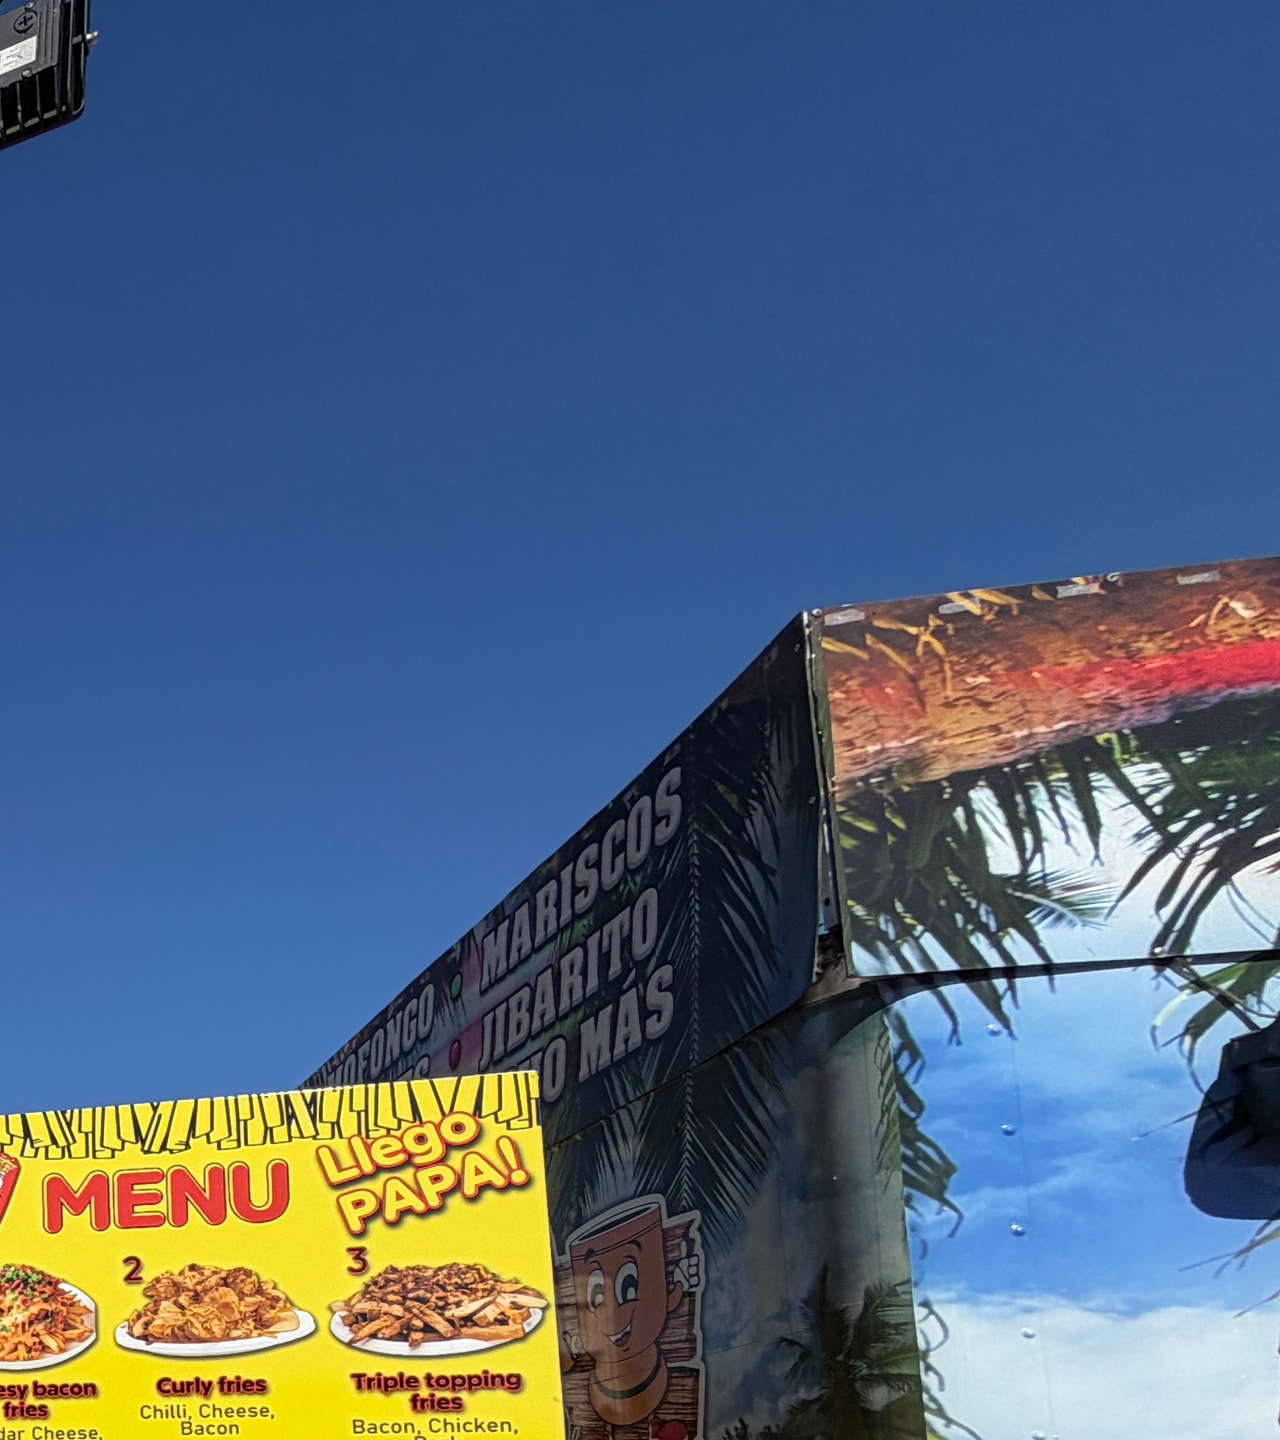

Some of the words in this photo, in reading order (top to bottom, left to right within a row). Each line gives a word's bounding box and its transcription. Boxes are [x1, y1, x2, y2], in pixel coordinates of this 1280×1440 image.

[479, 766, 682, 994] MARISCOS
[479, 888, 658, 1068] JIBARITO
[579, 963, 674, 1083] MÁS
[315, 1110, 482, 1186] Llego
[41, 1158, 291, 1234] MENU
[336, 1136, 530, 1236] PAPA!
[123, 1257, 144, 1284] 2
[345, 1246, 369, 1275] 3
[32, 1380, 98, 1398] bacon
[156, 1376, 213, 1397] Curly
[217, 1375, 268, 1394] fries
[350, 1371, 420, 1393] Triple
[424, 1369, 523, 1393] topping
[2, 1401, 49, 1420] fries
[140, 1405, 192, 1421] Chilli,
[199, 1403, 275, 1420] Cheese,
[408, 1393, 464, 1413] fries
[181, 1421, 240, 1436] Bacon
[352, 1419, 422, 1436] Bacon,
[428, 1418, 519, 1435] Chicken,
